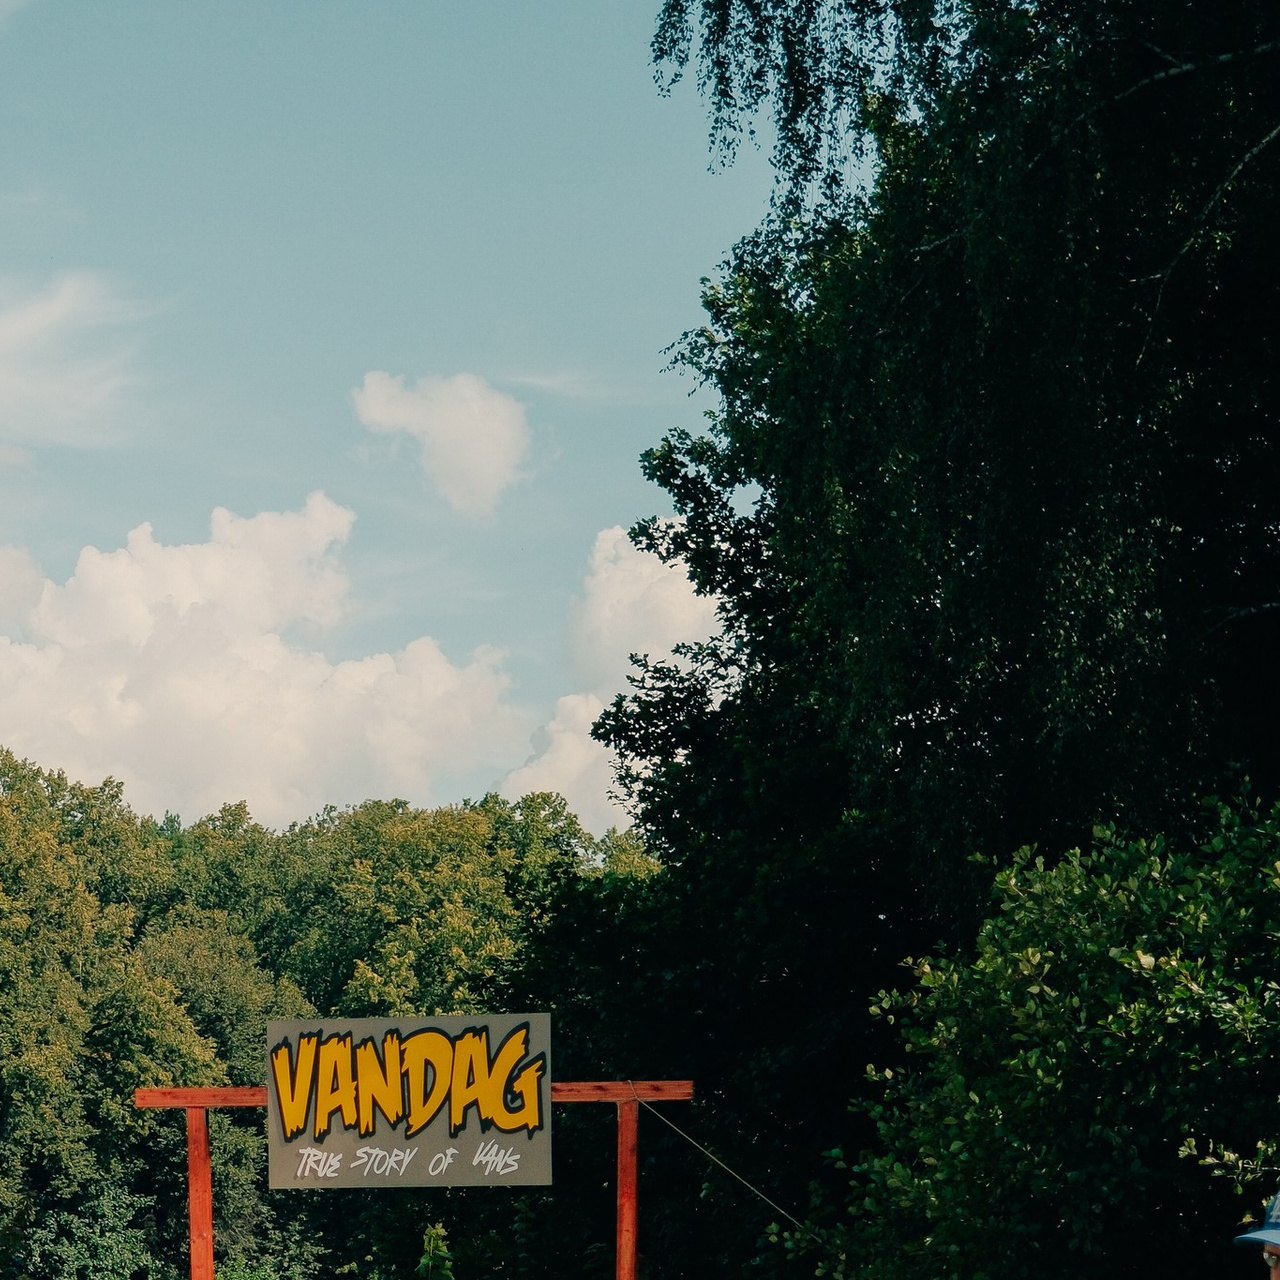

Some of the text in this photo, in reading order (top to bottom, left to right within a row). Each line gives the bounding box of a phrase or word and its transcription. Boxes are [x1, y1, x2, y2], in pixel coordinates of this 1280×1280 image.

[271, 1021, 546, 1144] VANDAG
[297, 1138, 521, 1177] TRUE STORY OF VANS
